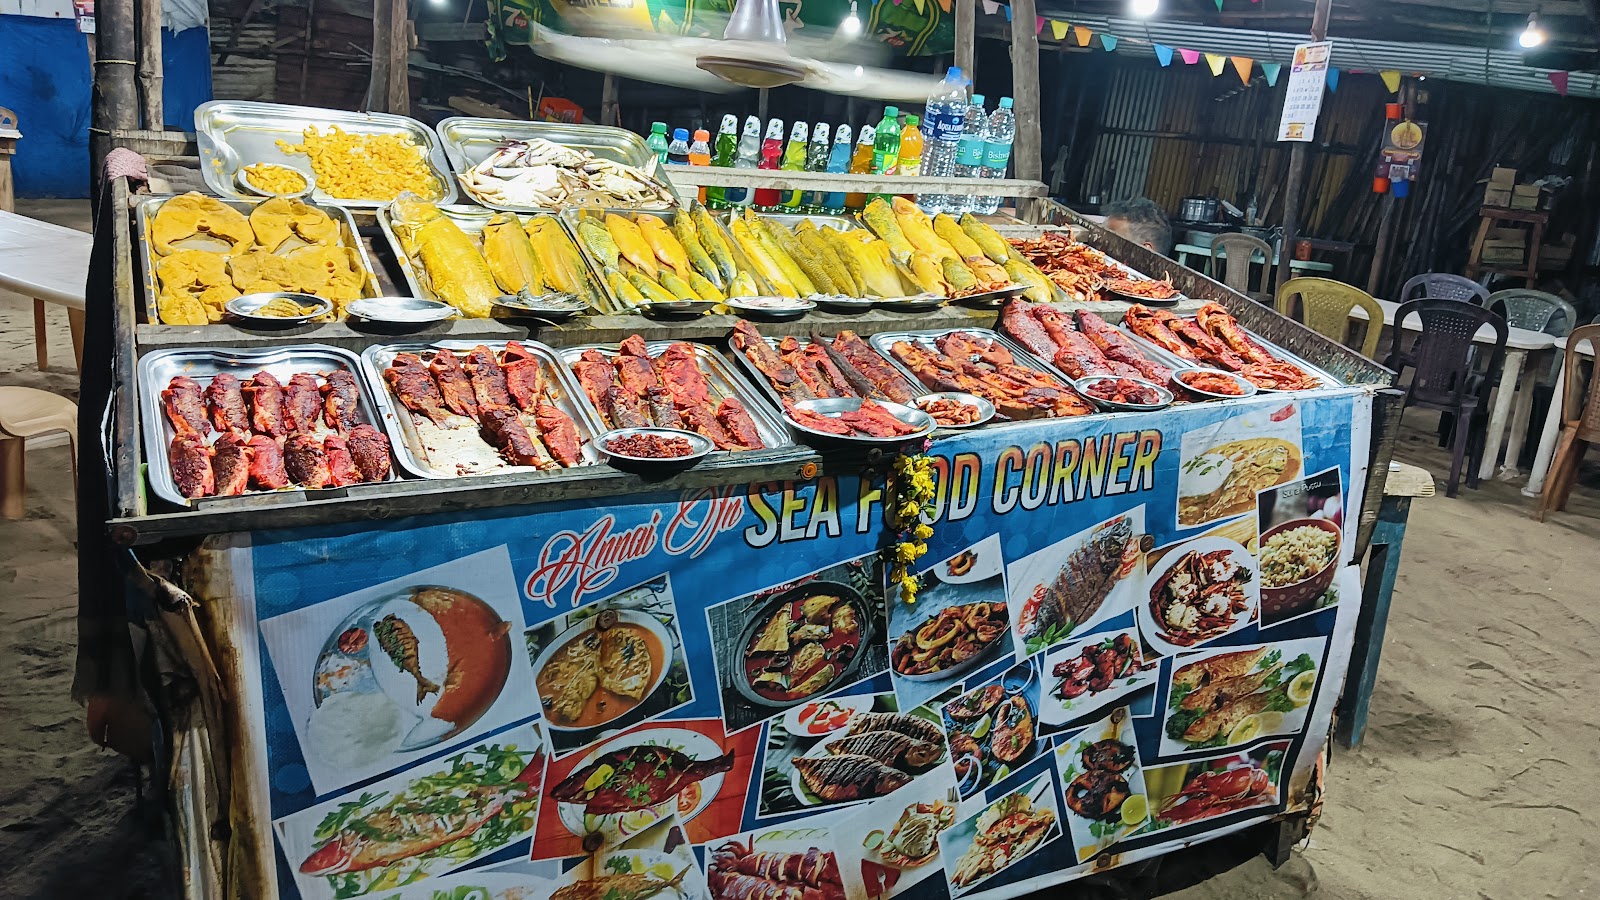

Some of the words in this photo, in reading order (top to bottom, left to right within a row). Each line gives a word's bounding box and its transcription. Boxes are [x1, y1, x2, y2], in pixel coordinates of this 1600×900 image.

[503, 6, 527, 28] 7up
[744, 473, 841, 547] SEA
[992, 428, 1163, 515] CORNER
[525, 510, 661, 607] Annai
